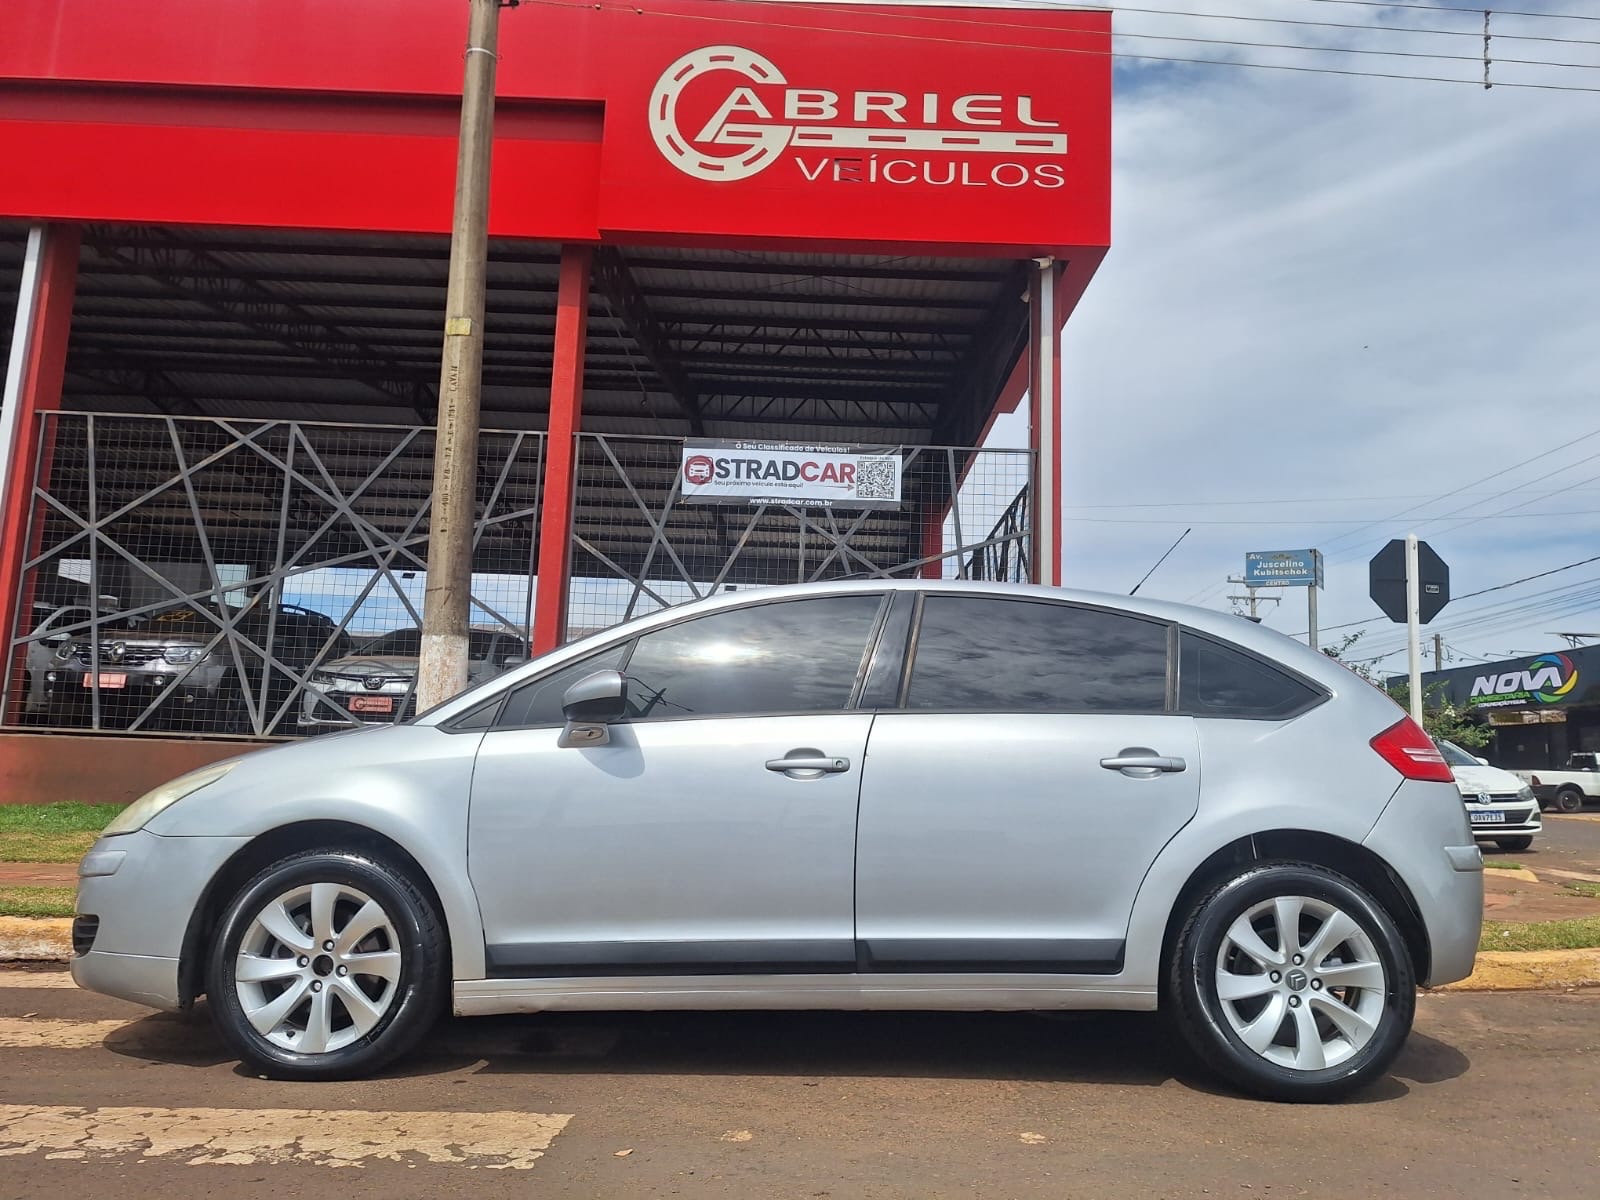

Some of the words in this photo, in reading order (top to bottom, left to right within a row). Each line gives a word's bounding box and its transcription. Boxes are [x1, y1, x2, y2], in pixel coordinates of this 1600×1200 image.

[795, 153, 1065, 189] VEÍCULOS
[743, 443, 756, 451] Seu
[757, 443, 803, 452] Classificado
[715, 458, 856, 484] STRADCAR
[749, 497, 833, 507] www.stradcar.com.br
[1257, 560, 1304, 568] Juscelino
[1470, 666, 1562, 696] NOVA
